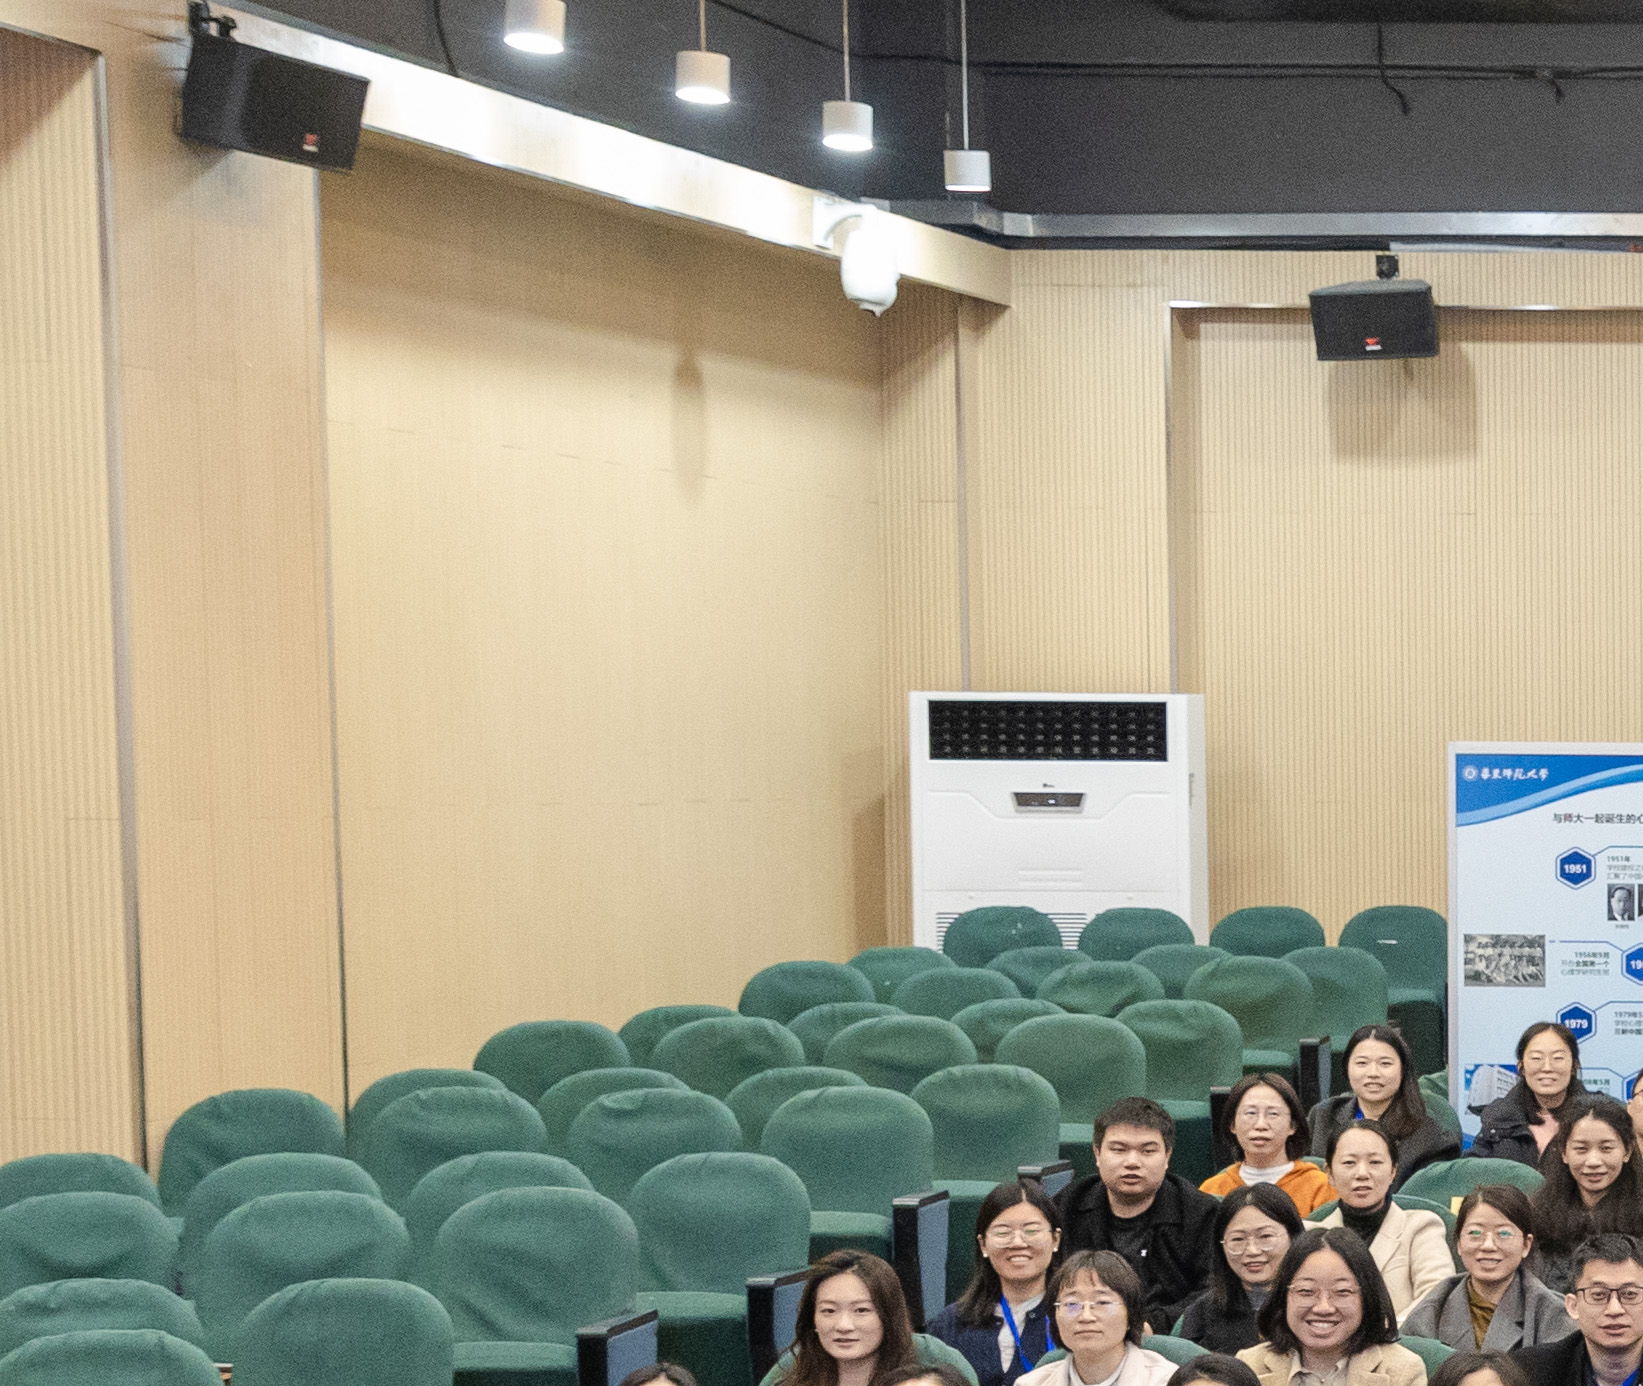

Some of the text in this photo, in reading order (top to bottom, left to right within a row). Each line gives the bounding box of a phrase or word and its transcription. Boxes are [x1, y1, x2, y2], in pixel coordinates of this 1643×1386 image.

[1607, 855, 1631, 863] 1951年
[1563, 864, 1588, 874] 1951
[1564, 1019, 1588, 1029] 1979
